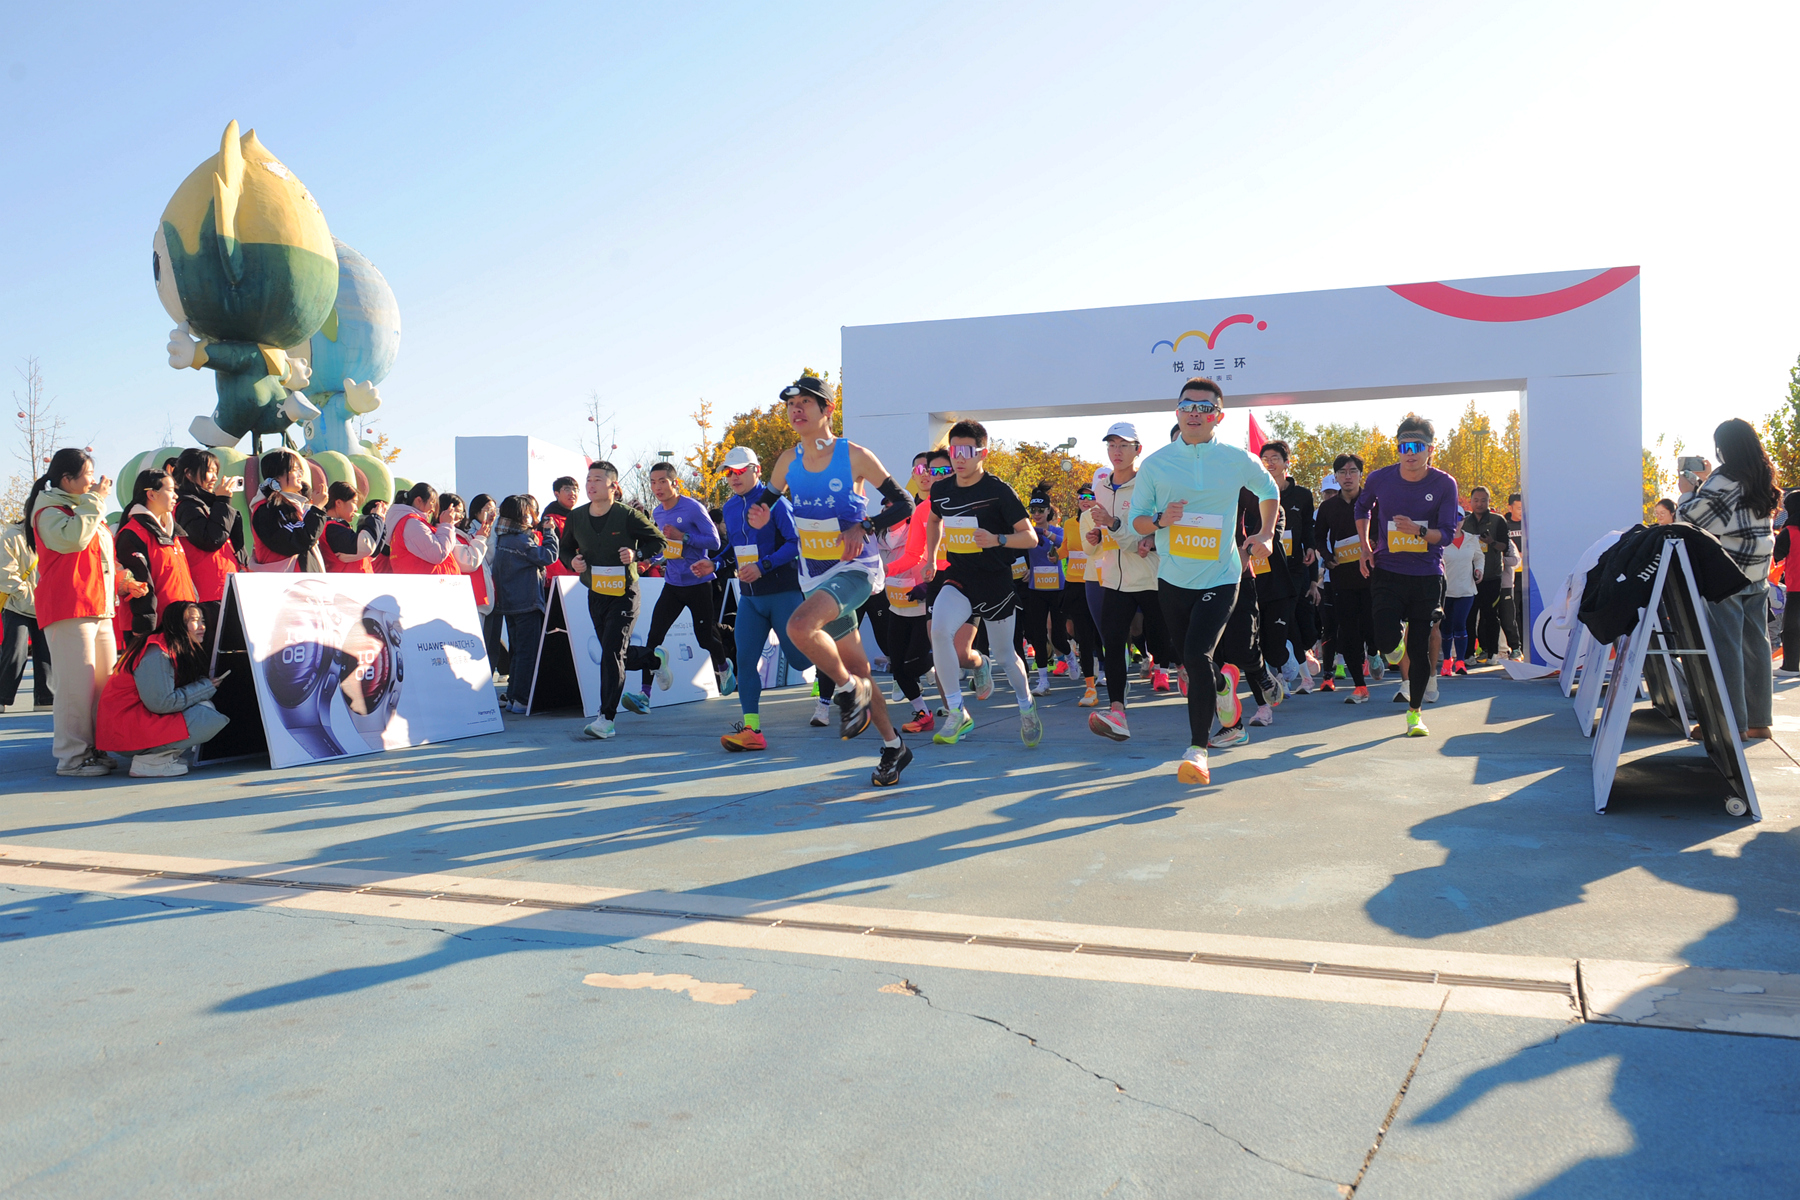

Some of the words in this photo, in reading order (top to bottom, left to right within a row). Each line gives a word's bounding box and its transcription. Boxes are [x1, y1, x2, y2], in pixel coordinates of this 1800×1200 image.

[1172, 356, 1246, 373] 悦动三环
[949, 534, 976, 544] A1024
[1174, 533, 1217, 548] A1008
[1392, 536, 1425, 545] A1462
[665, 545, 681, 556] 1312
[1338, 546, 1363, 558] A1161
[1251, 558, 1267, 567] 192
[595, 580, 624, 589] A1450
[1036, 576, 1057, 584] A1007
[416, 641, 446, 652] HUAWEI
[282, 645, 306, 664] 08
[357, 649, 375, 665] 10
[355, 665, 375, 681] 08
